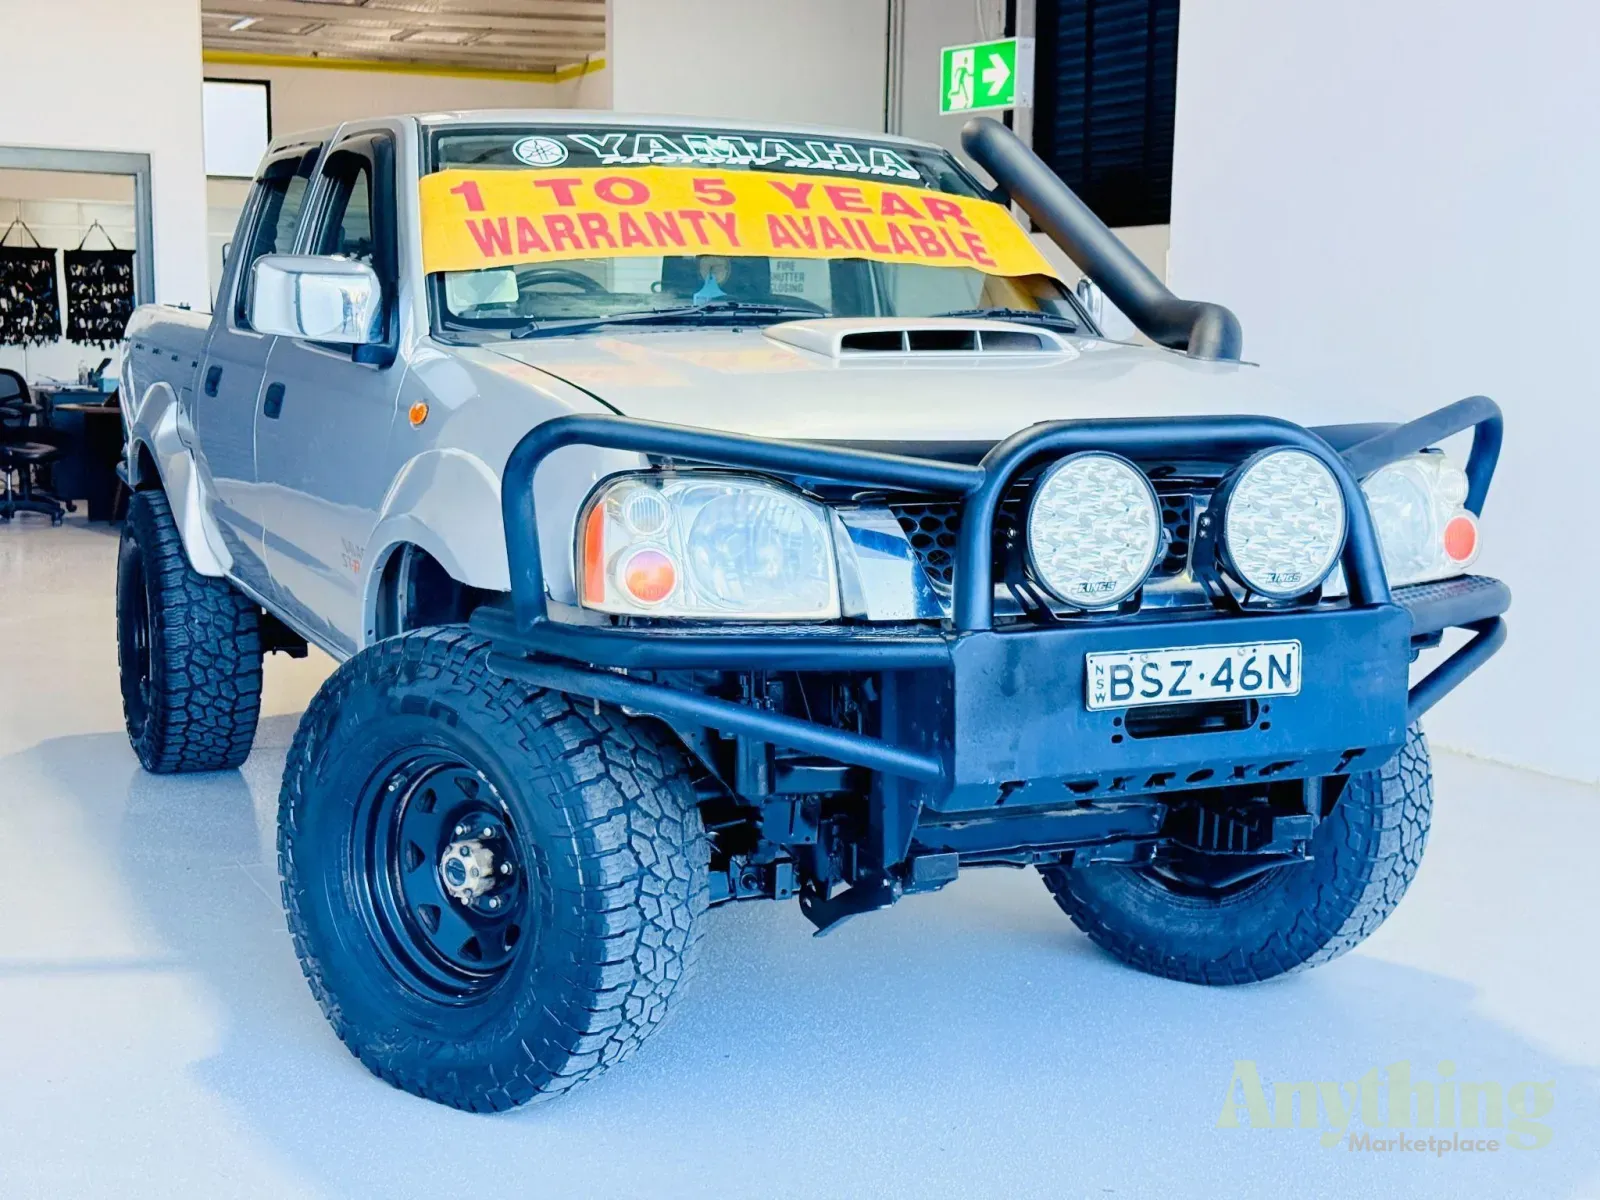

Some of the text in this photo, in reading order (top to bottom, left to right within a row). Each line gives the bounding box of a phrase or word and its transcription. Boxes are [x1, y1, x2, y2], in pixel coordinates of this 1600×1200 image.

[566, 132, 919, 174] YAMAHA
[601, 155, 921, 180] FACTORY RACING
[450, 176, 974, 228] 1 TO 5 YEAR
[465, 209, 998, 267] WARRANTY AVAILABLE
[1077, 581, 1117, 594] KINGS
[1095, 664, 1107, 704] NSW
